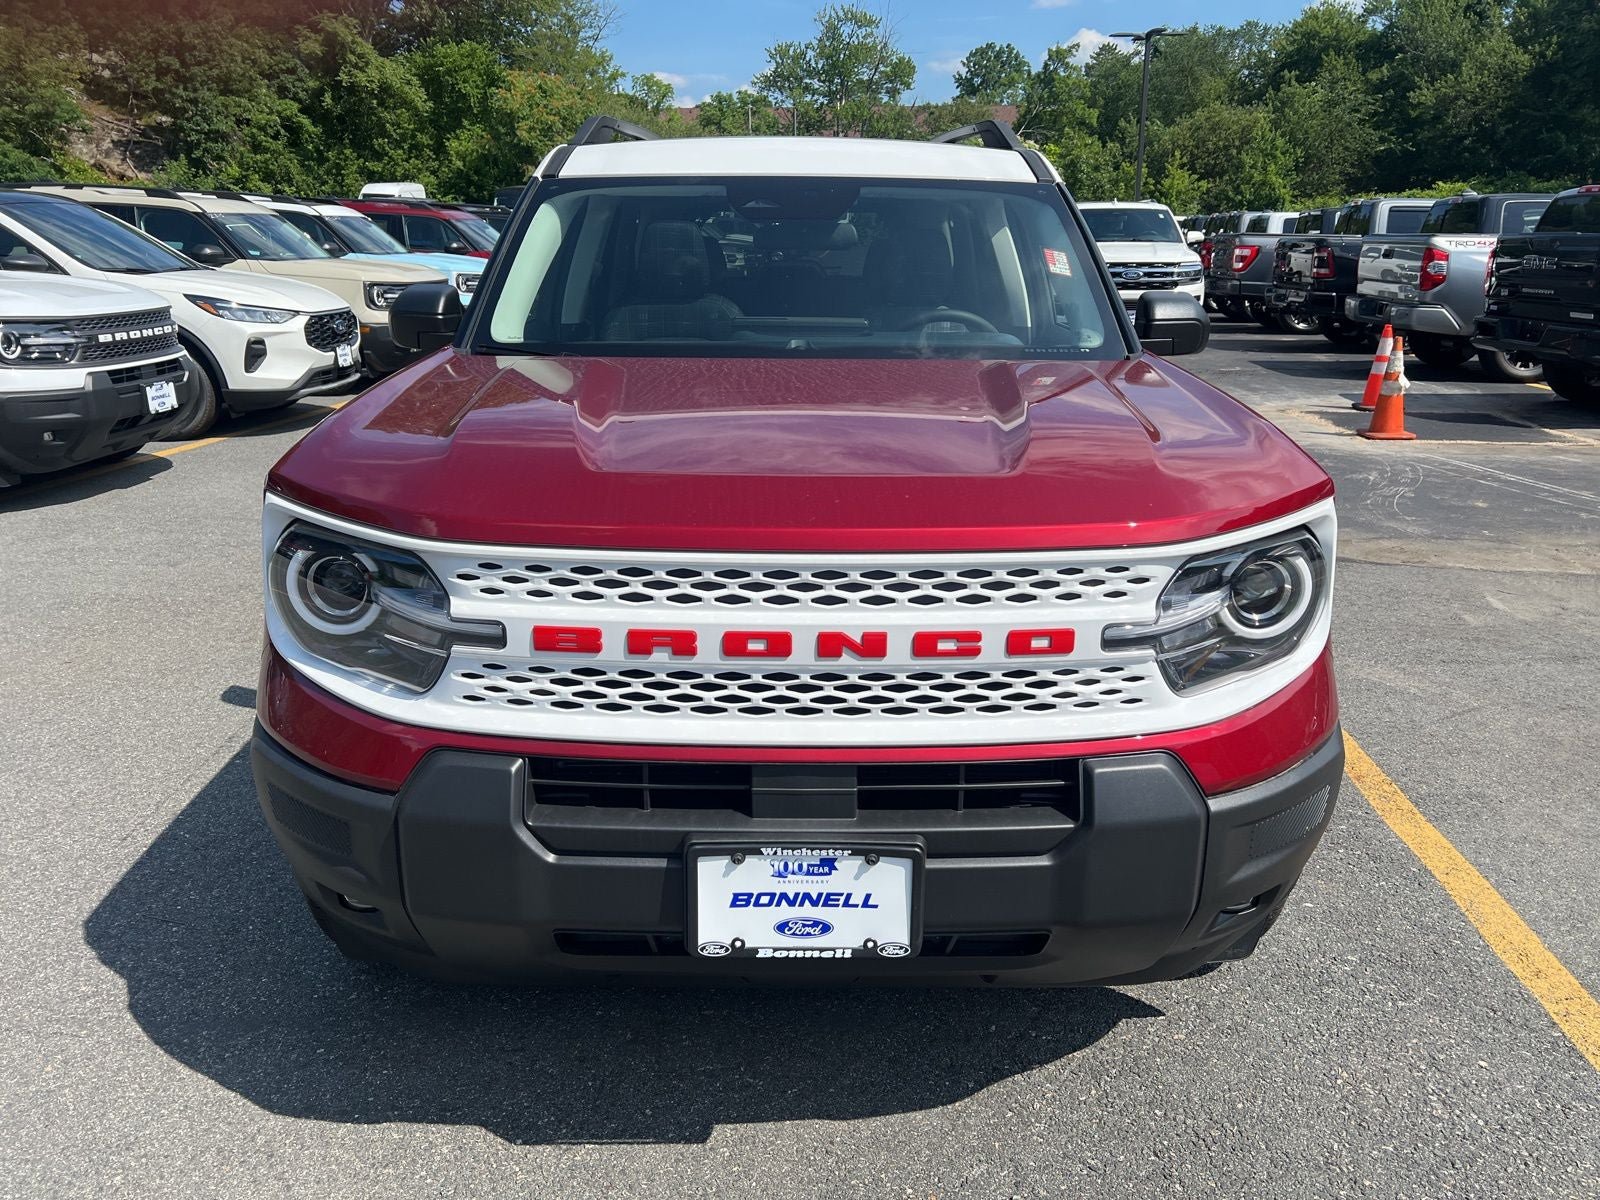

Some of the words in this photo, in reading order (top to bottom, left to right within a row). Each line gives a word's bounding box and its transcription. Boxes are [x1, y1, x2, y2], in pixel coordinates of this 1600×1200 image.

[1522, 254, 1558, 270] GMC
[98, 325, 172, 342] BRONCO
[532, 625, 1076, 658] BRONCO
[760, 847, 852, 856] Winchester
[770, 858, 808, 876] 100
[808, 866, 830, 874] YEAR
[729, 892, 879, 908] BONNELL
[784, 920, 822, 935] Ford
[702, 945, 726, 954] Ford
[756, 948, 852, 958] Bonnell
[882, 946, 906, 955] Ford
